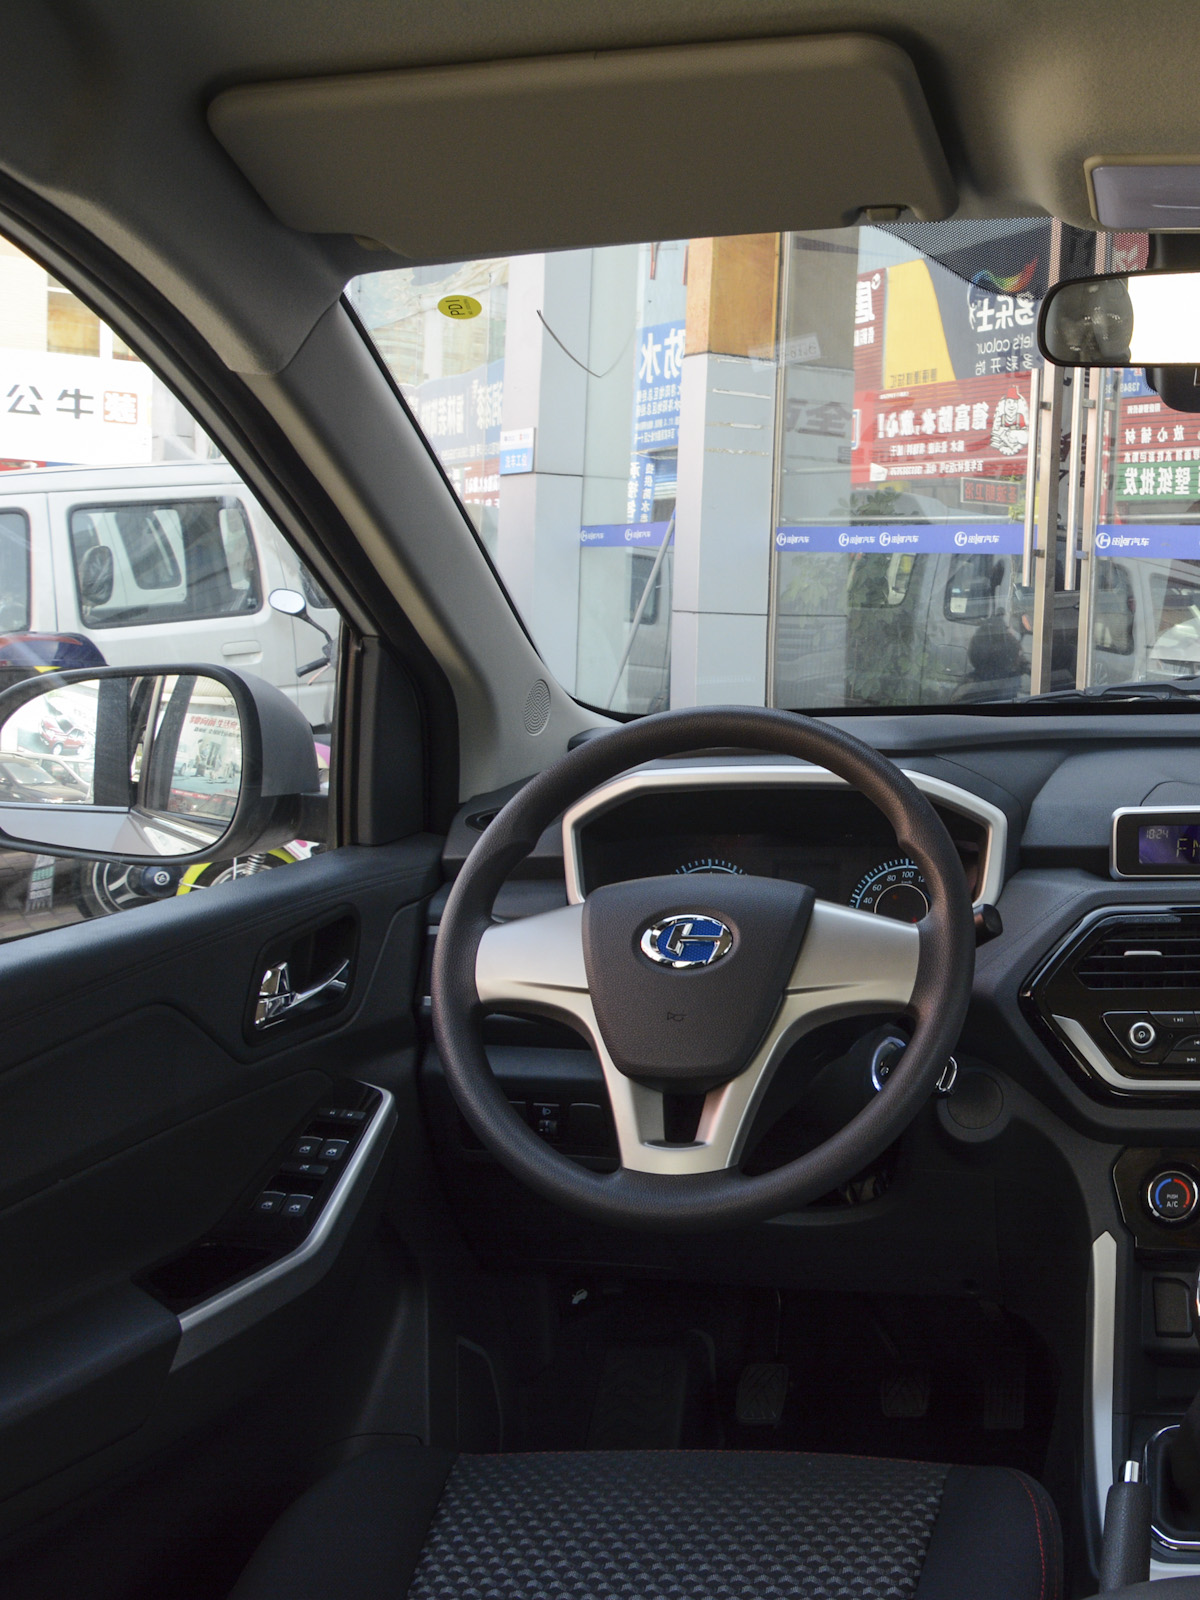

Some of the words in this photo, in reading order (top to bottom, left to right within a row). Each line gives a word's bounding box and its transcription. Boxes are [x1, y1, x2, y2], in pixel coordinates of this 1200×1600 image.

[886, 874, 897, 882] 80
[872, 883, 883, 891] 60
[863, 896, 873, 904] 40
